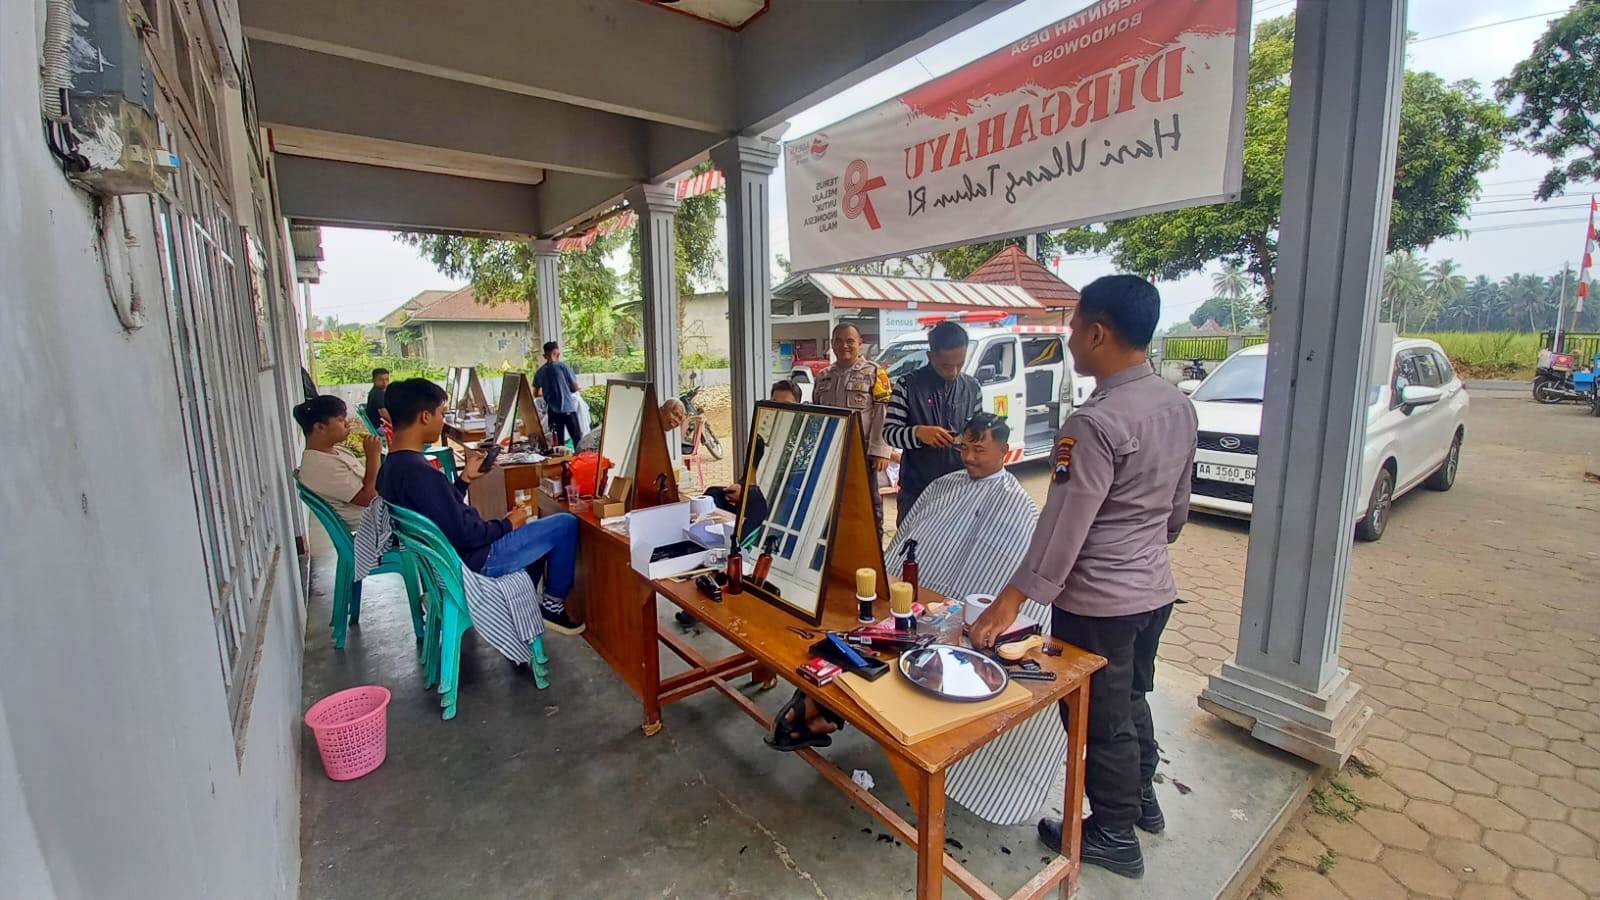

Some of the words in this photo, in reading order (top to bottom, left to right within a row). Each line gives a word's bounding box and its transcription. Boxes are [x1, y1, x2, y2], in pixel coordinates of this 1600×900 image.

[886, 318, 913, 327] Sensus
[1200, 464, 1210, 473] AA
[1216, 466, 1240, 478] 1560
